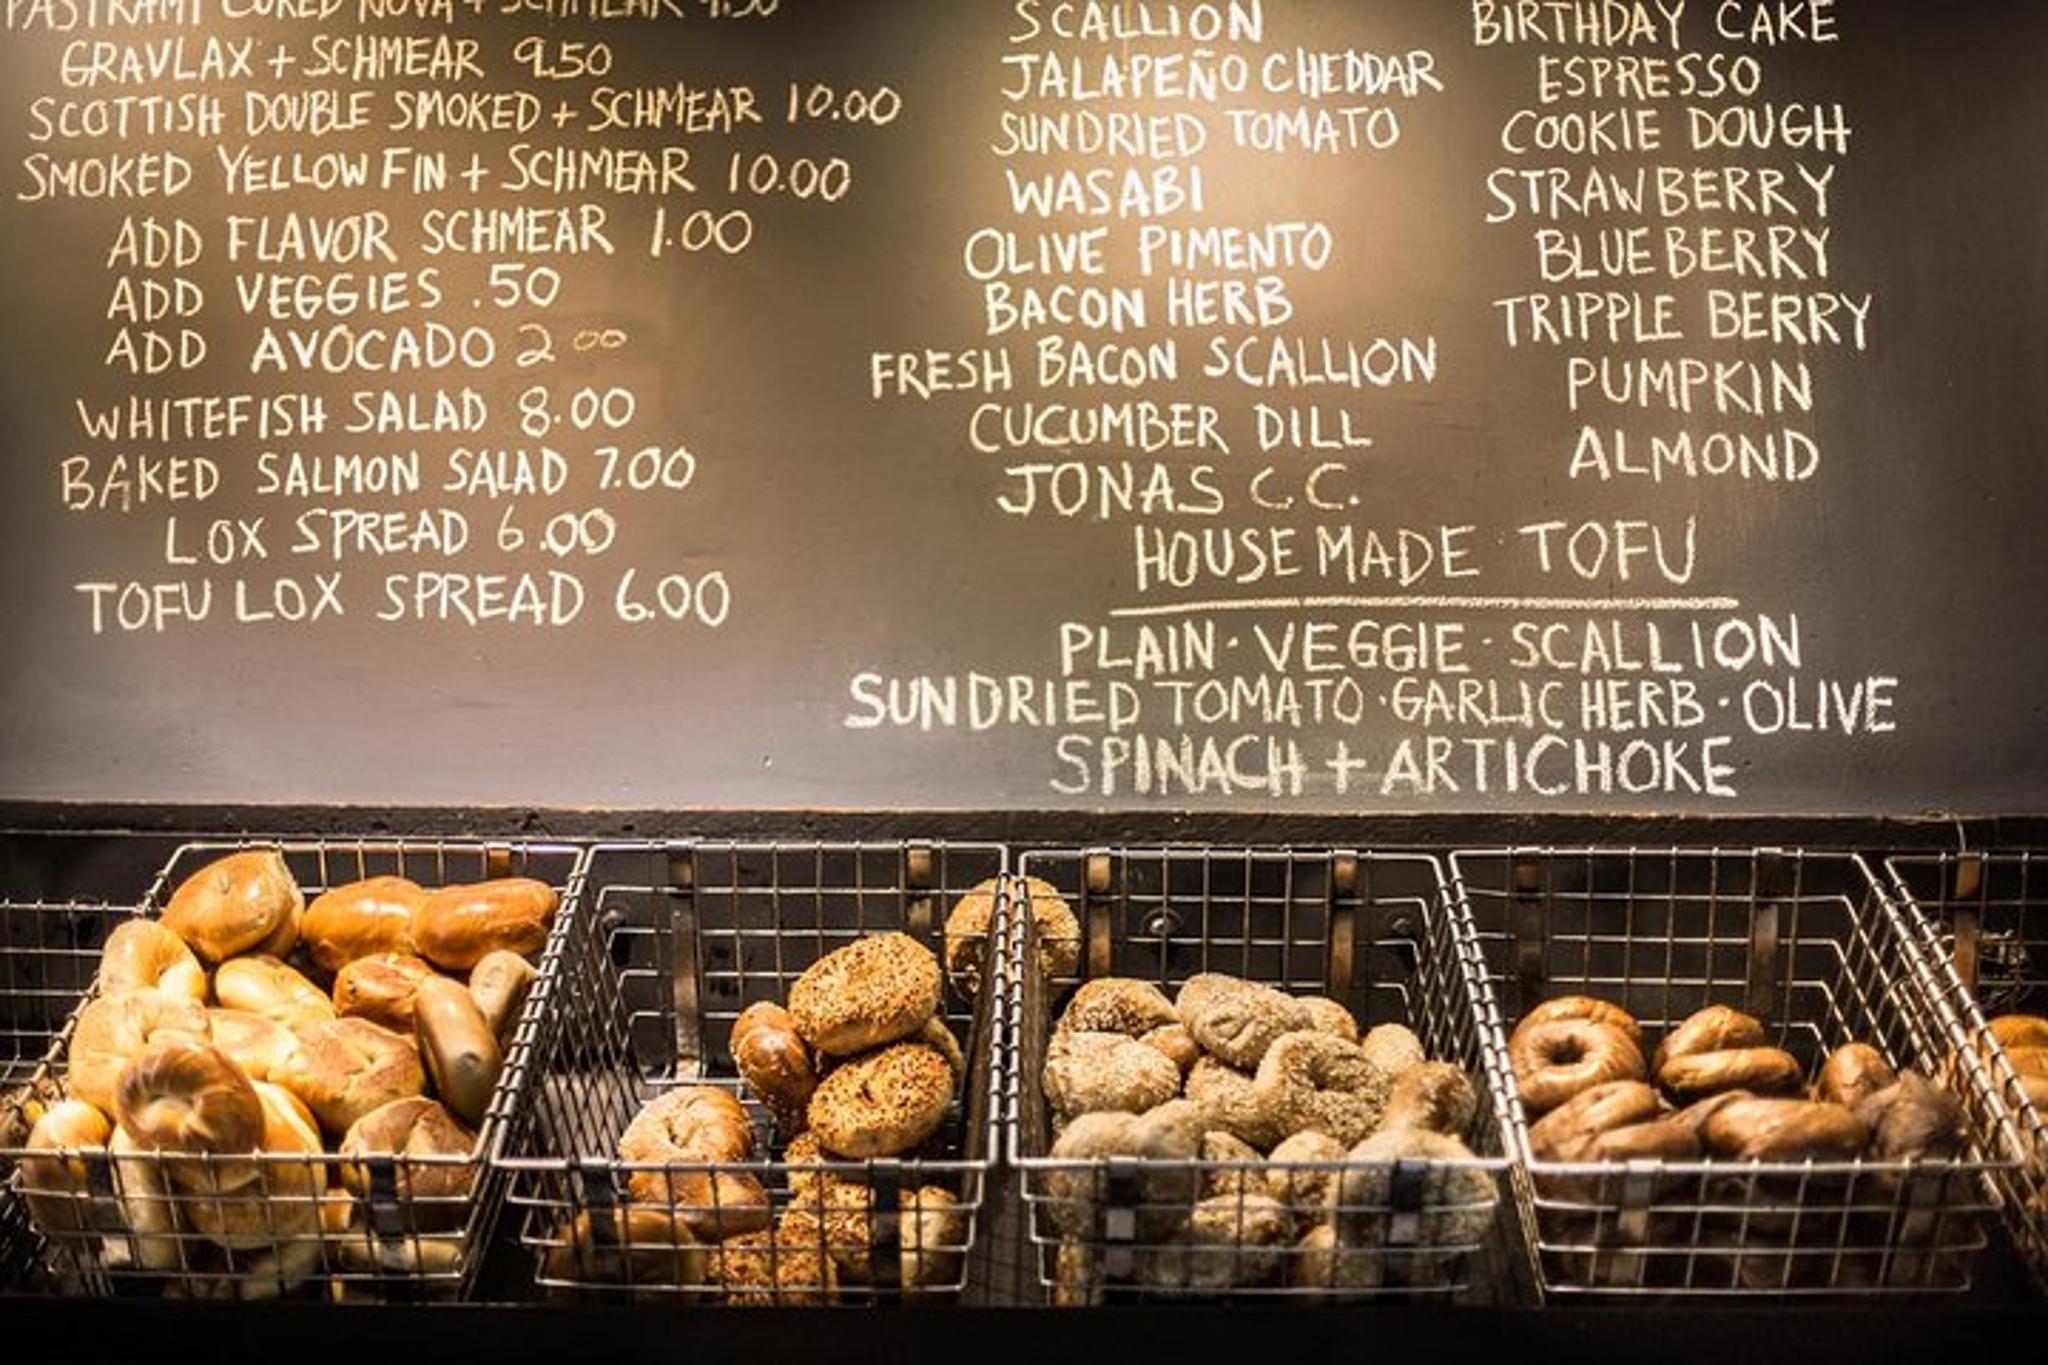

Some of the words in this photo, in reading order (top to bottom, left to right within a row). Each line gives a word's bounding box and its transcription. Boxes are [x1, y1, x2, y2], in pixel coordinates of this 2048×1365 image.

[1010, 0, 1262, 42] SCALLION
[1473, 0, 1684, 50] BIRTHDAY
[1717, 0, 1838, 43] CAKE
[61, 37, 252, 87] GRAVLAX
[304, 35, 484, 80] SCHMEAR
[514, 37, 612, 78] 9.50
[1001, 50, 1247, 101] JALAPEÑO
[1263, 48, 1444, 97] CHEDDAR
[1540, 53, 1760, 103] ESPRESSO
[29, 94, 225, 141] SCOTTISH
[246, 90, 373, 136] DOUBLE
[390, 91, 540, 132] SMOKED
[588, 82, 762, 133] SCHMEAR
[788, 84, 901, 125] 10.00
[992, 111, 1205, 158] SUNDRIED
[1225, 107, 1400, 153] TOMATO
[1502, 108, 1660, 154] COOKIE
[1688, 103, 1851, 154] DOUGH
[17, 152, 191, 201] SMOKED
[502, 144, 695, 194] SCHMEAR
[730, 153, 850, 201] 10.00
[1006, 166, 1202, 217] WASABI
[108, 217, 202, 268] ADD
[227, 211, 397, 262] FLAVOR
[422, 205, 614, 254] SCHMEAR
[651, 208, 752, 256] 1.00
[964, 228, 1106, 279] OLIVE
[1139, 222, 1332, 276] PIMENTO
[108, 277, 203, 322] ADD
[236, 270, 439, 316] VEGGIES
[986, 282, 1144, 335] BACON
[1169, 276, 1292, 327] HERB
[1494, 292, 1682, 346] TRIPPLE
[1709, 290, 1871, 350] BERRY
[106, 328, 205, 373] ADD
[251, 322, 494, 373] AVOCADO
[872, 349, 1011, 399] FRESH
[1038, 336, 1176, 387] BACON
[1204, 337, 1436, 387] SCALLION
[76, 395, 327, 441] WHITEFISH
[345, 388, 486, 433] SALAD
[519, 386, 635, 437] 8.00
[1569, 357, 1812, 415] PUMPKIN
[970, 402, 1229, 454] CUCUMBER
[1254, 403, 1372, 451] DILL
[1570, 426, 1819, 481] ALMOND
[61, 455, 219, 511] BAKED
[258, 451, 419, 496] SALMON
[444, 447, 567, 498] SALAD
[595, 447, 695, 489] 7.00
[997, 462, 1223, 519] JONAS
[166, 517, 267, 564] LOX
[292, 508, 467, 560] SPREAD
[498, 505, 616, 556] 6.00
[1136, 525, 1299, 591] HOUSE
[1317, 525, 1479, 586] MADE
[1518, 516, 1695, 584] TOFU
[75, 579, 211, 633] TOFU
[236, 572, 343, 621] LOX
[377, 570, 584, 625] SPREAD
[616, 569, 729, 626] 6.00
[1061, 620, 1214, 679] PLAIN
[1254, 620, 1469, 672] VEGGIE
[1511, 614, 1801, 673] SCALLION
[845, 672, 1140, 732] SUNDRIED
[1154, 674, 1363, 726] TOMATO
[1392, 677, 1563, 729] GARLIC
[1582, 679, 1705, 731] HERB
[1743, 677, 1898, 735] OLIVE
[1050, 734, 1304, 797] SPINACH
[1381, 734, 1737, 797] ARTICHOKE
